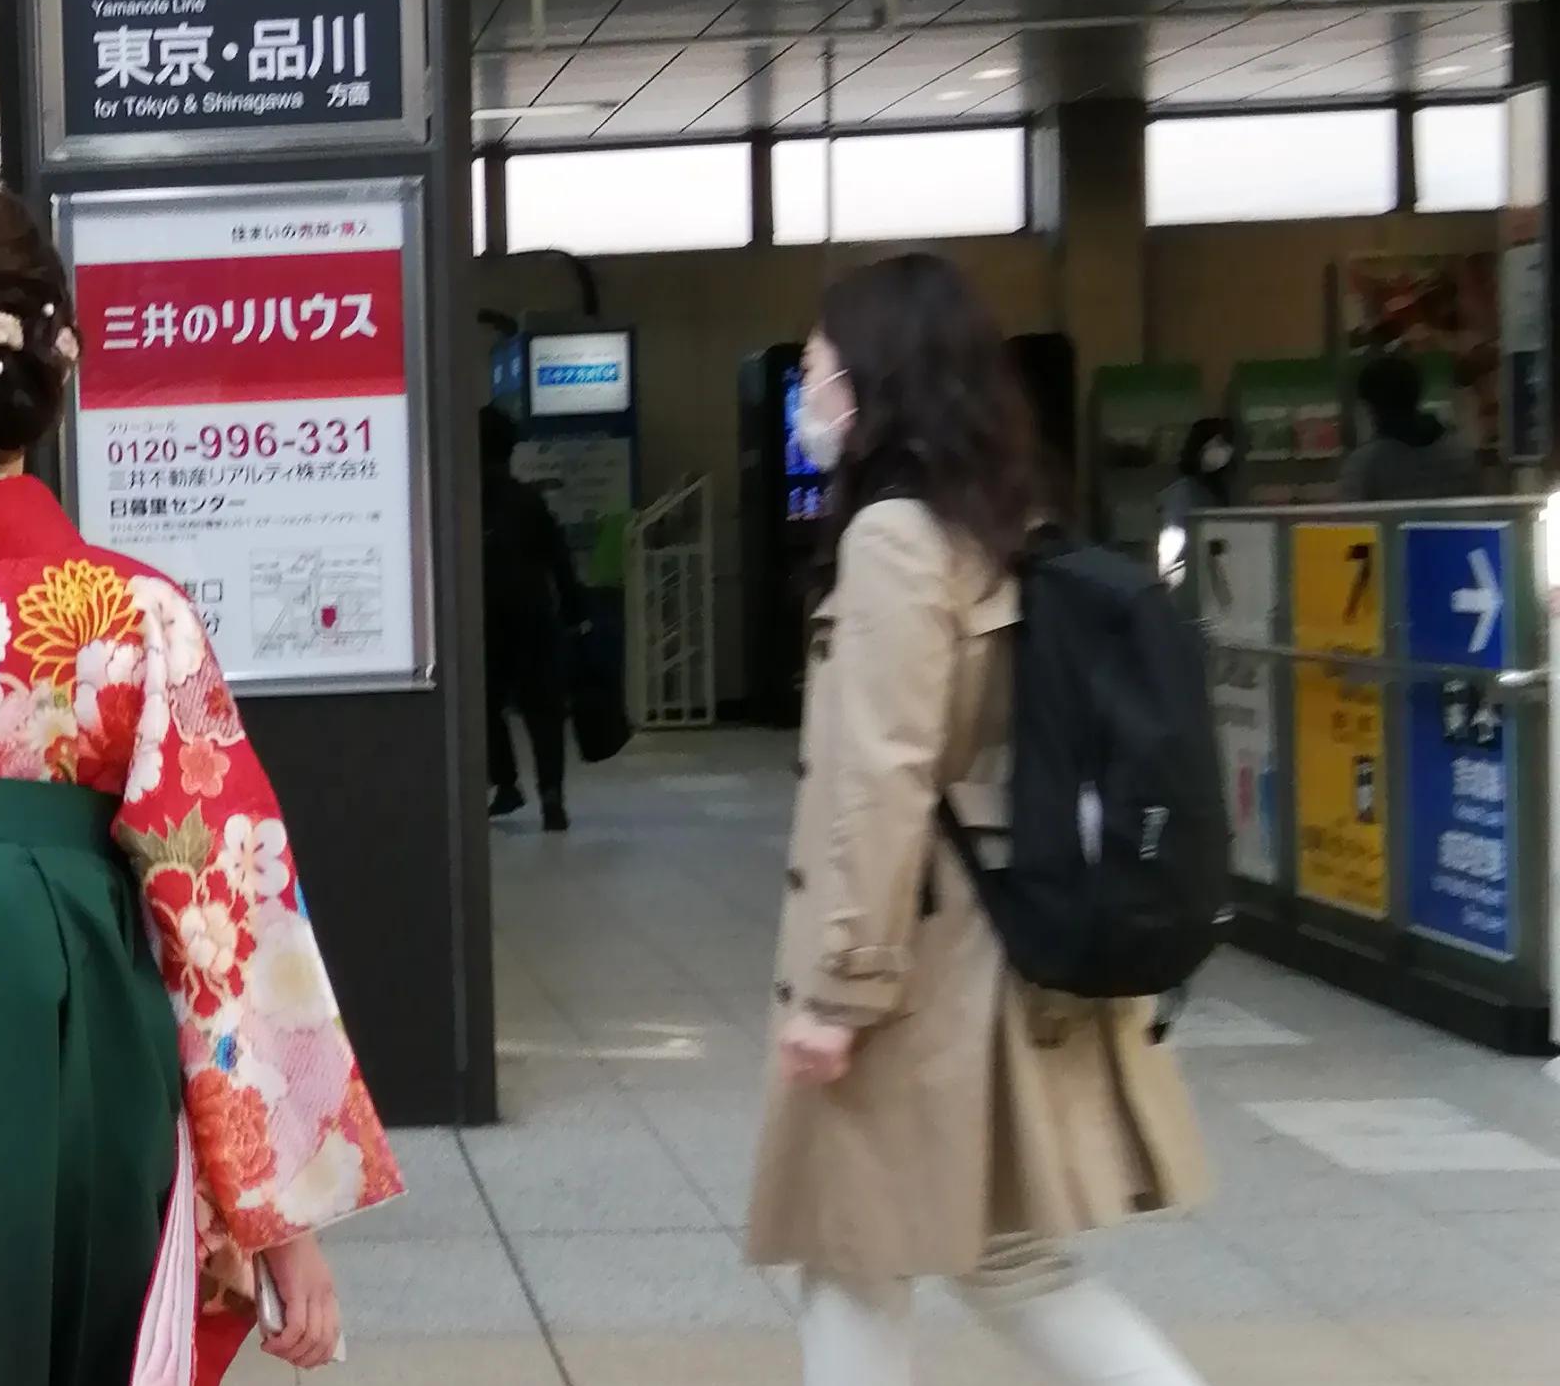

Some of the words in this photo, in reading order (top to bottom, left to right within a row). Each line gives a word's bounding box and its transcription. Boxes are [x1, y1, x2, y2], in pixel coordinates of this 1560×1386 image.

[93, 13, 368, 89] 東京・品川
[94, 98, 119, 119] for
[184, 93, 198, 114] &
[202, 90, 305, 116] Shinagawa
[326, 81, 371, 108] 方面
[102, 293, 378, 351] 三井のリハウス
[107, 414, 373, 465] 0120-996-331
[109, 494, 247, 519] 日暮里センター
